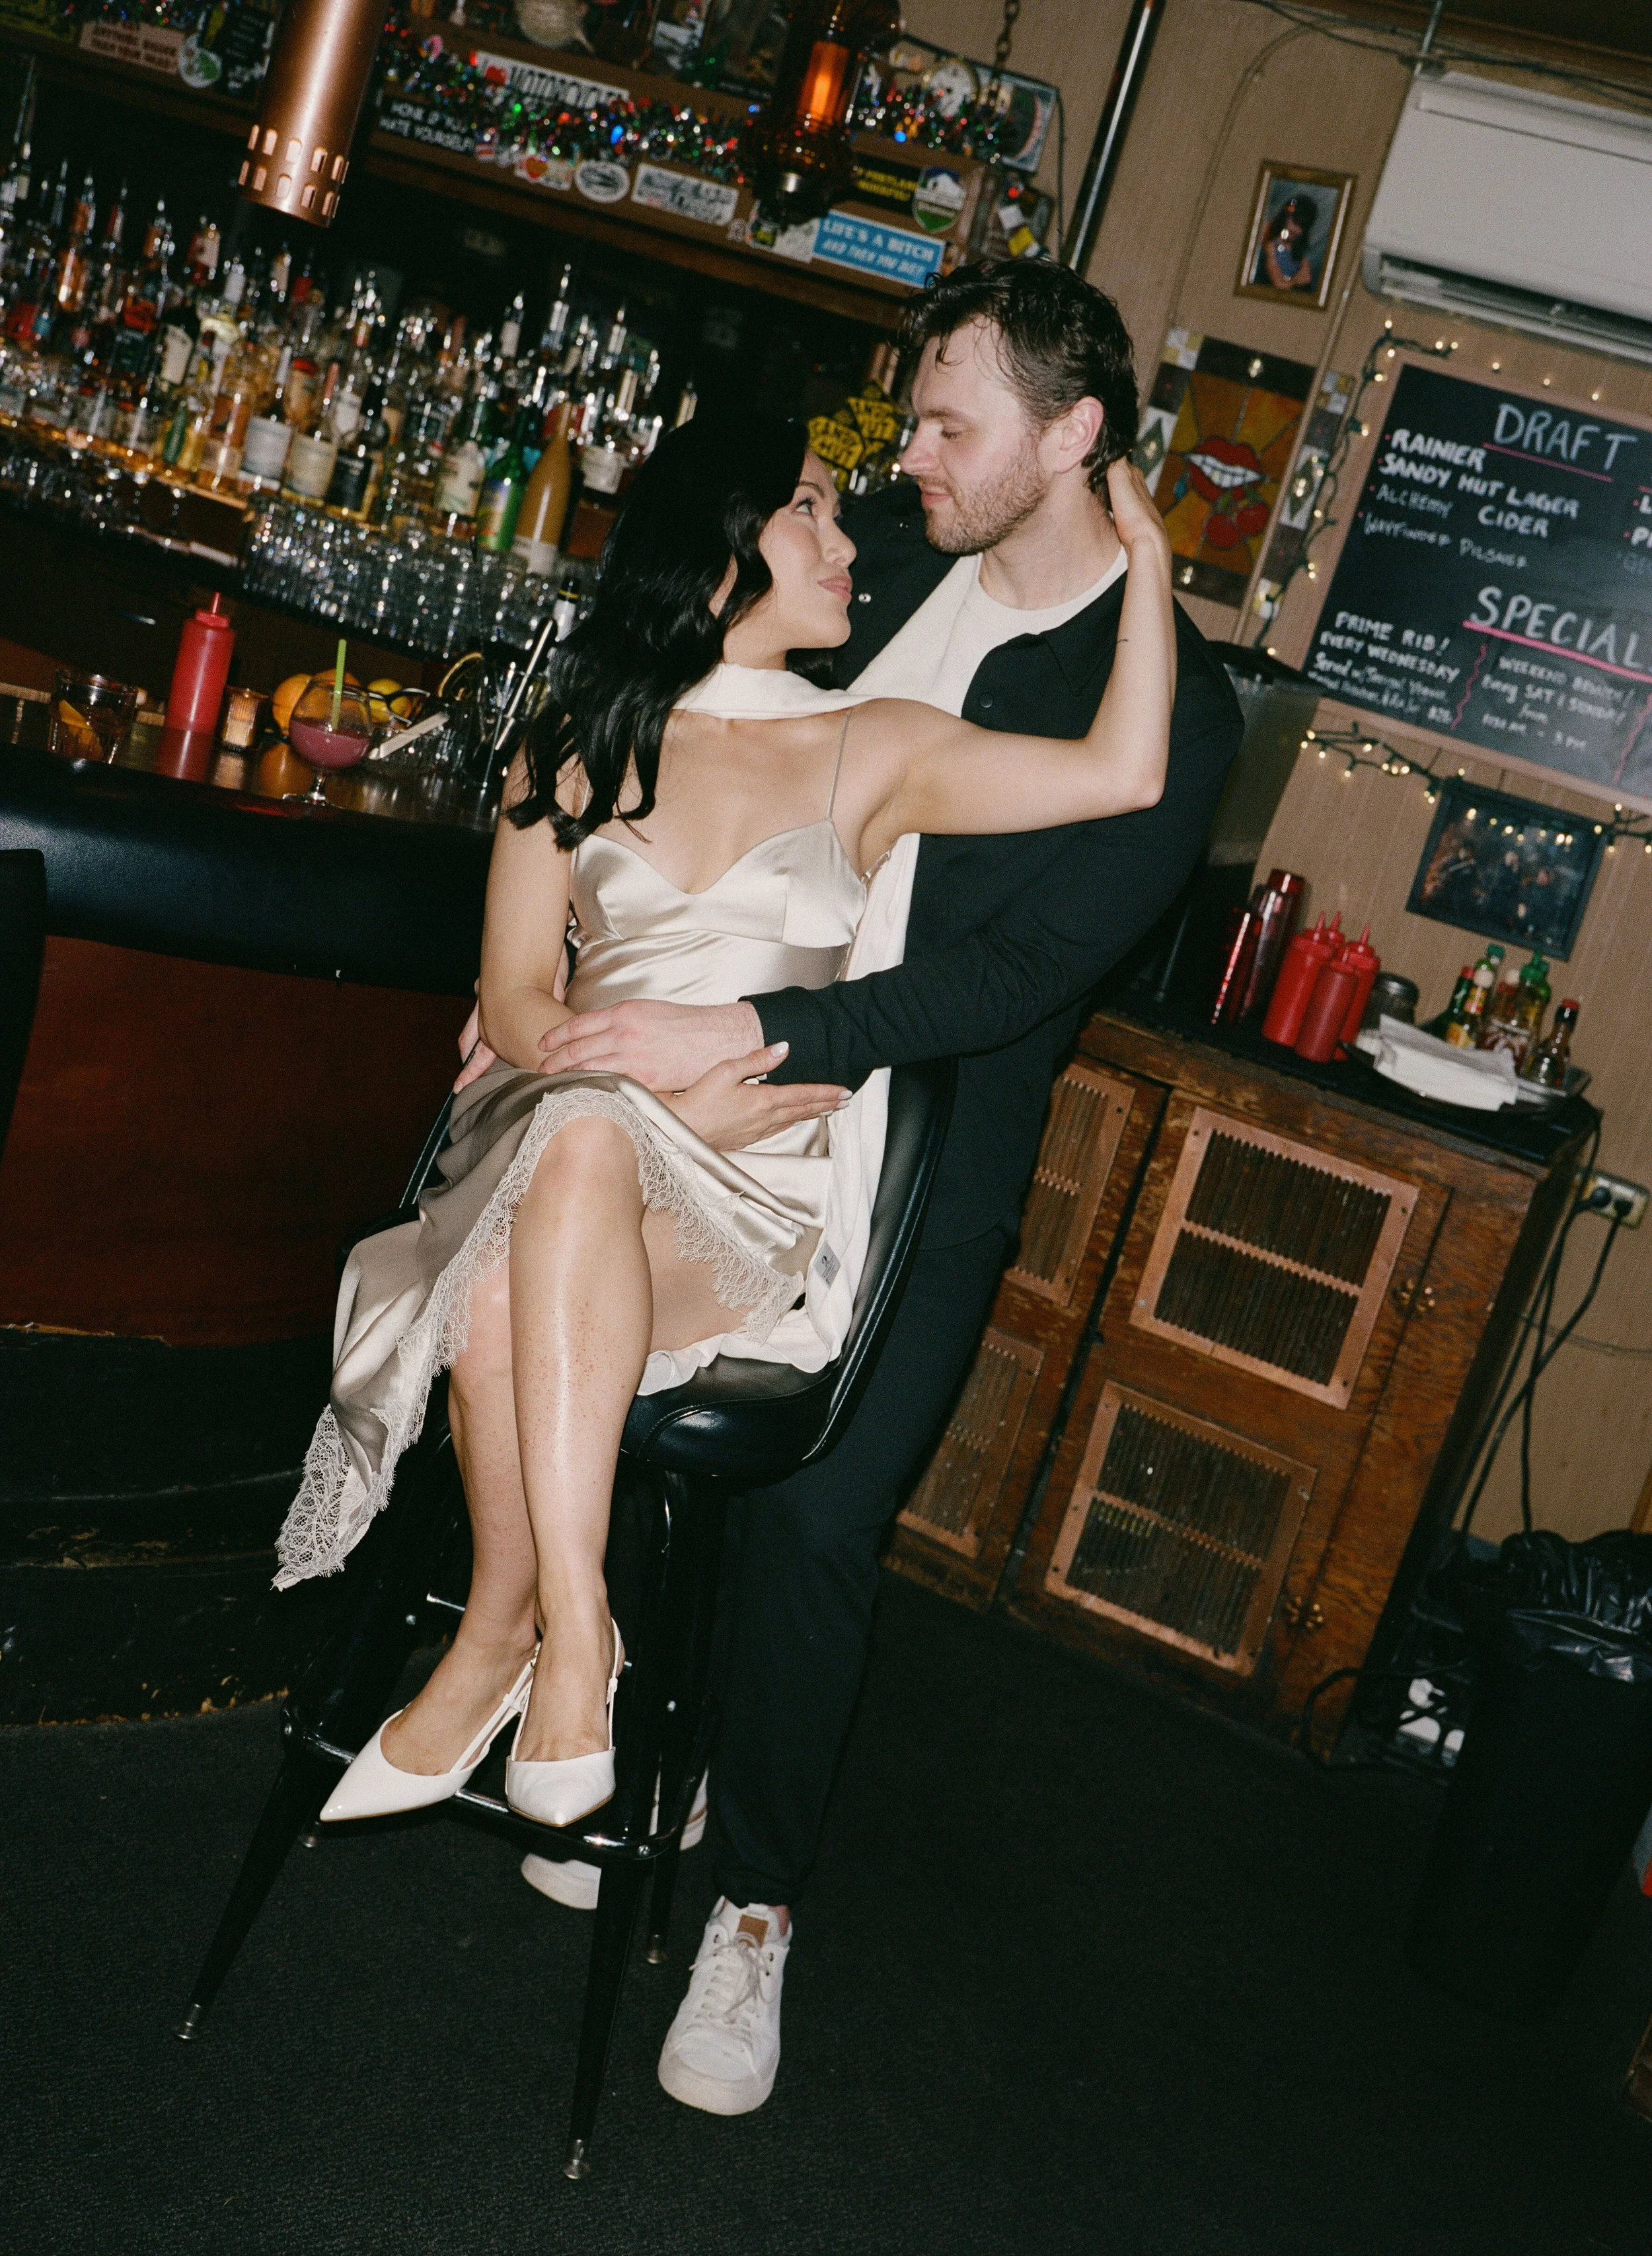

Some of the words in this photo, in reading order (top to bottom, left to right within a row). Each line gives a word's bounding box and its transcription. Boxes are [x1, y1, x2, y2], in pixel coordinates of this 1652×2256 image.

[379, 116, 410, 136] HATE
[823, 219, 868, 243] LIFE'S
[872, 234, 883, 247] A
[887, 237, 934, 262] BITCH
[1390, 428, 1486, 473] RAINIER
[1493, 402, 1639, 472] DRAFT
[1379, 453, 1452, 489] SANDY
[1457, 473, 1505, 498] HUT
[1506, 486, 1580, 520] LAGER
[1376, 483, 1453, 519] ALCHEMY
[1478, 505, 1550, 539] CIDER
[1459, 537, 1528, 569] PILSNER
[1335, 611, 1394, 641] PRIME
[1402, 629, 1450, 657] RIB!
[1470, 585, 1652, 673] SPECIAL
[1314, 651, 1353, 677] Served
[1320, 630, 1365, 654] EVERY
[1367, 642, 1460, 684] WEDNESDAY
[1498, 656, 1567, 684] WEEKEND
[1481, 673, 1518, 704] Every
[1524, 683, 1555, 704] SAT
